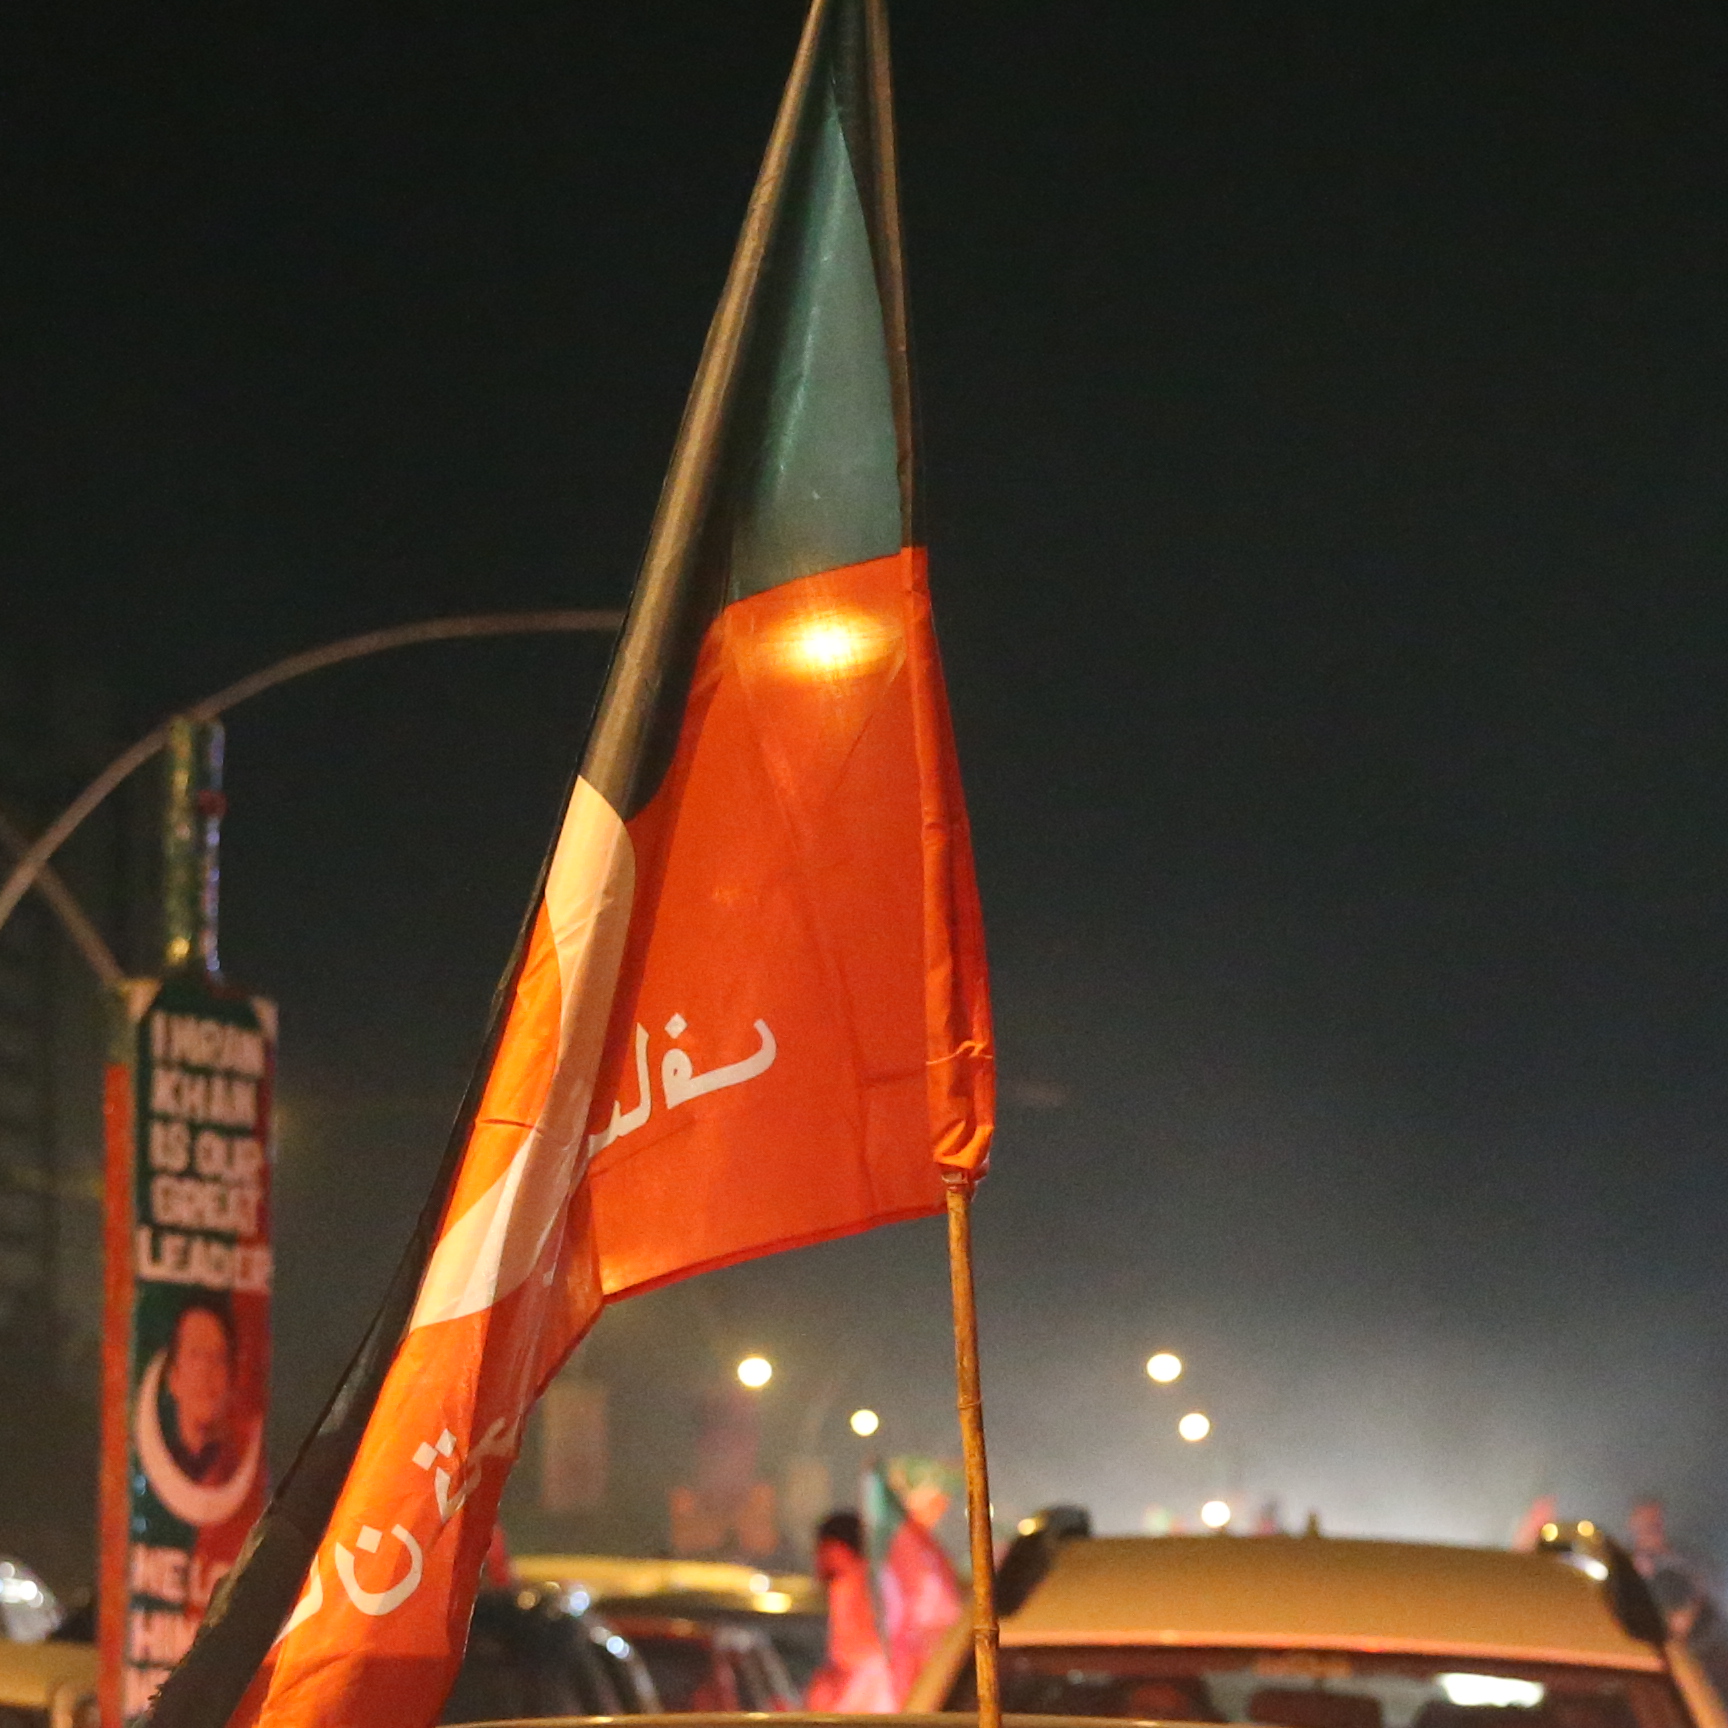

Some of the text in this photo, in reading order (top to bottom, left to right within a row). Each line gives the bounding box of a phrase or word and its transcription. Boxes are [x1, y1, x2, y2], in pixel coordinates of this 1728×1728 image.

[152, 1010, 264, 1078] IMRAN
[152, 1066, 258, 1128] KHAN
[151, 1120, 263, 1182] IS OUR
[152, 1175, 261, 1235] GREAT
[138, 1225, 272, 1294] LEADER
